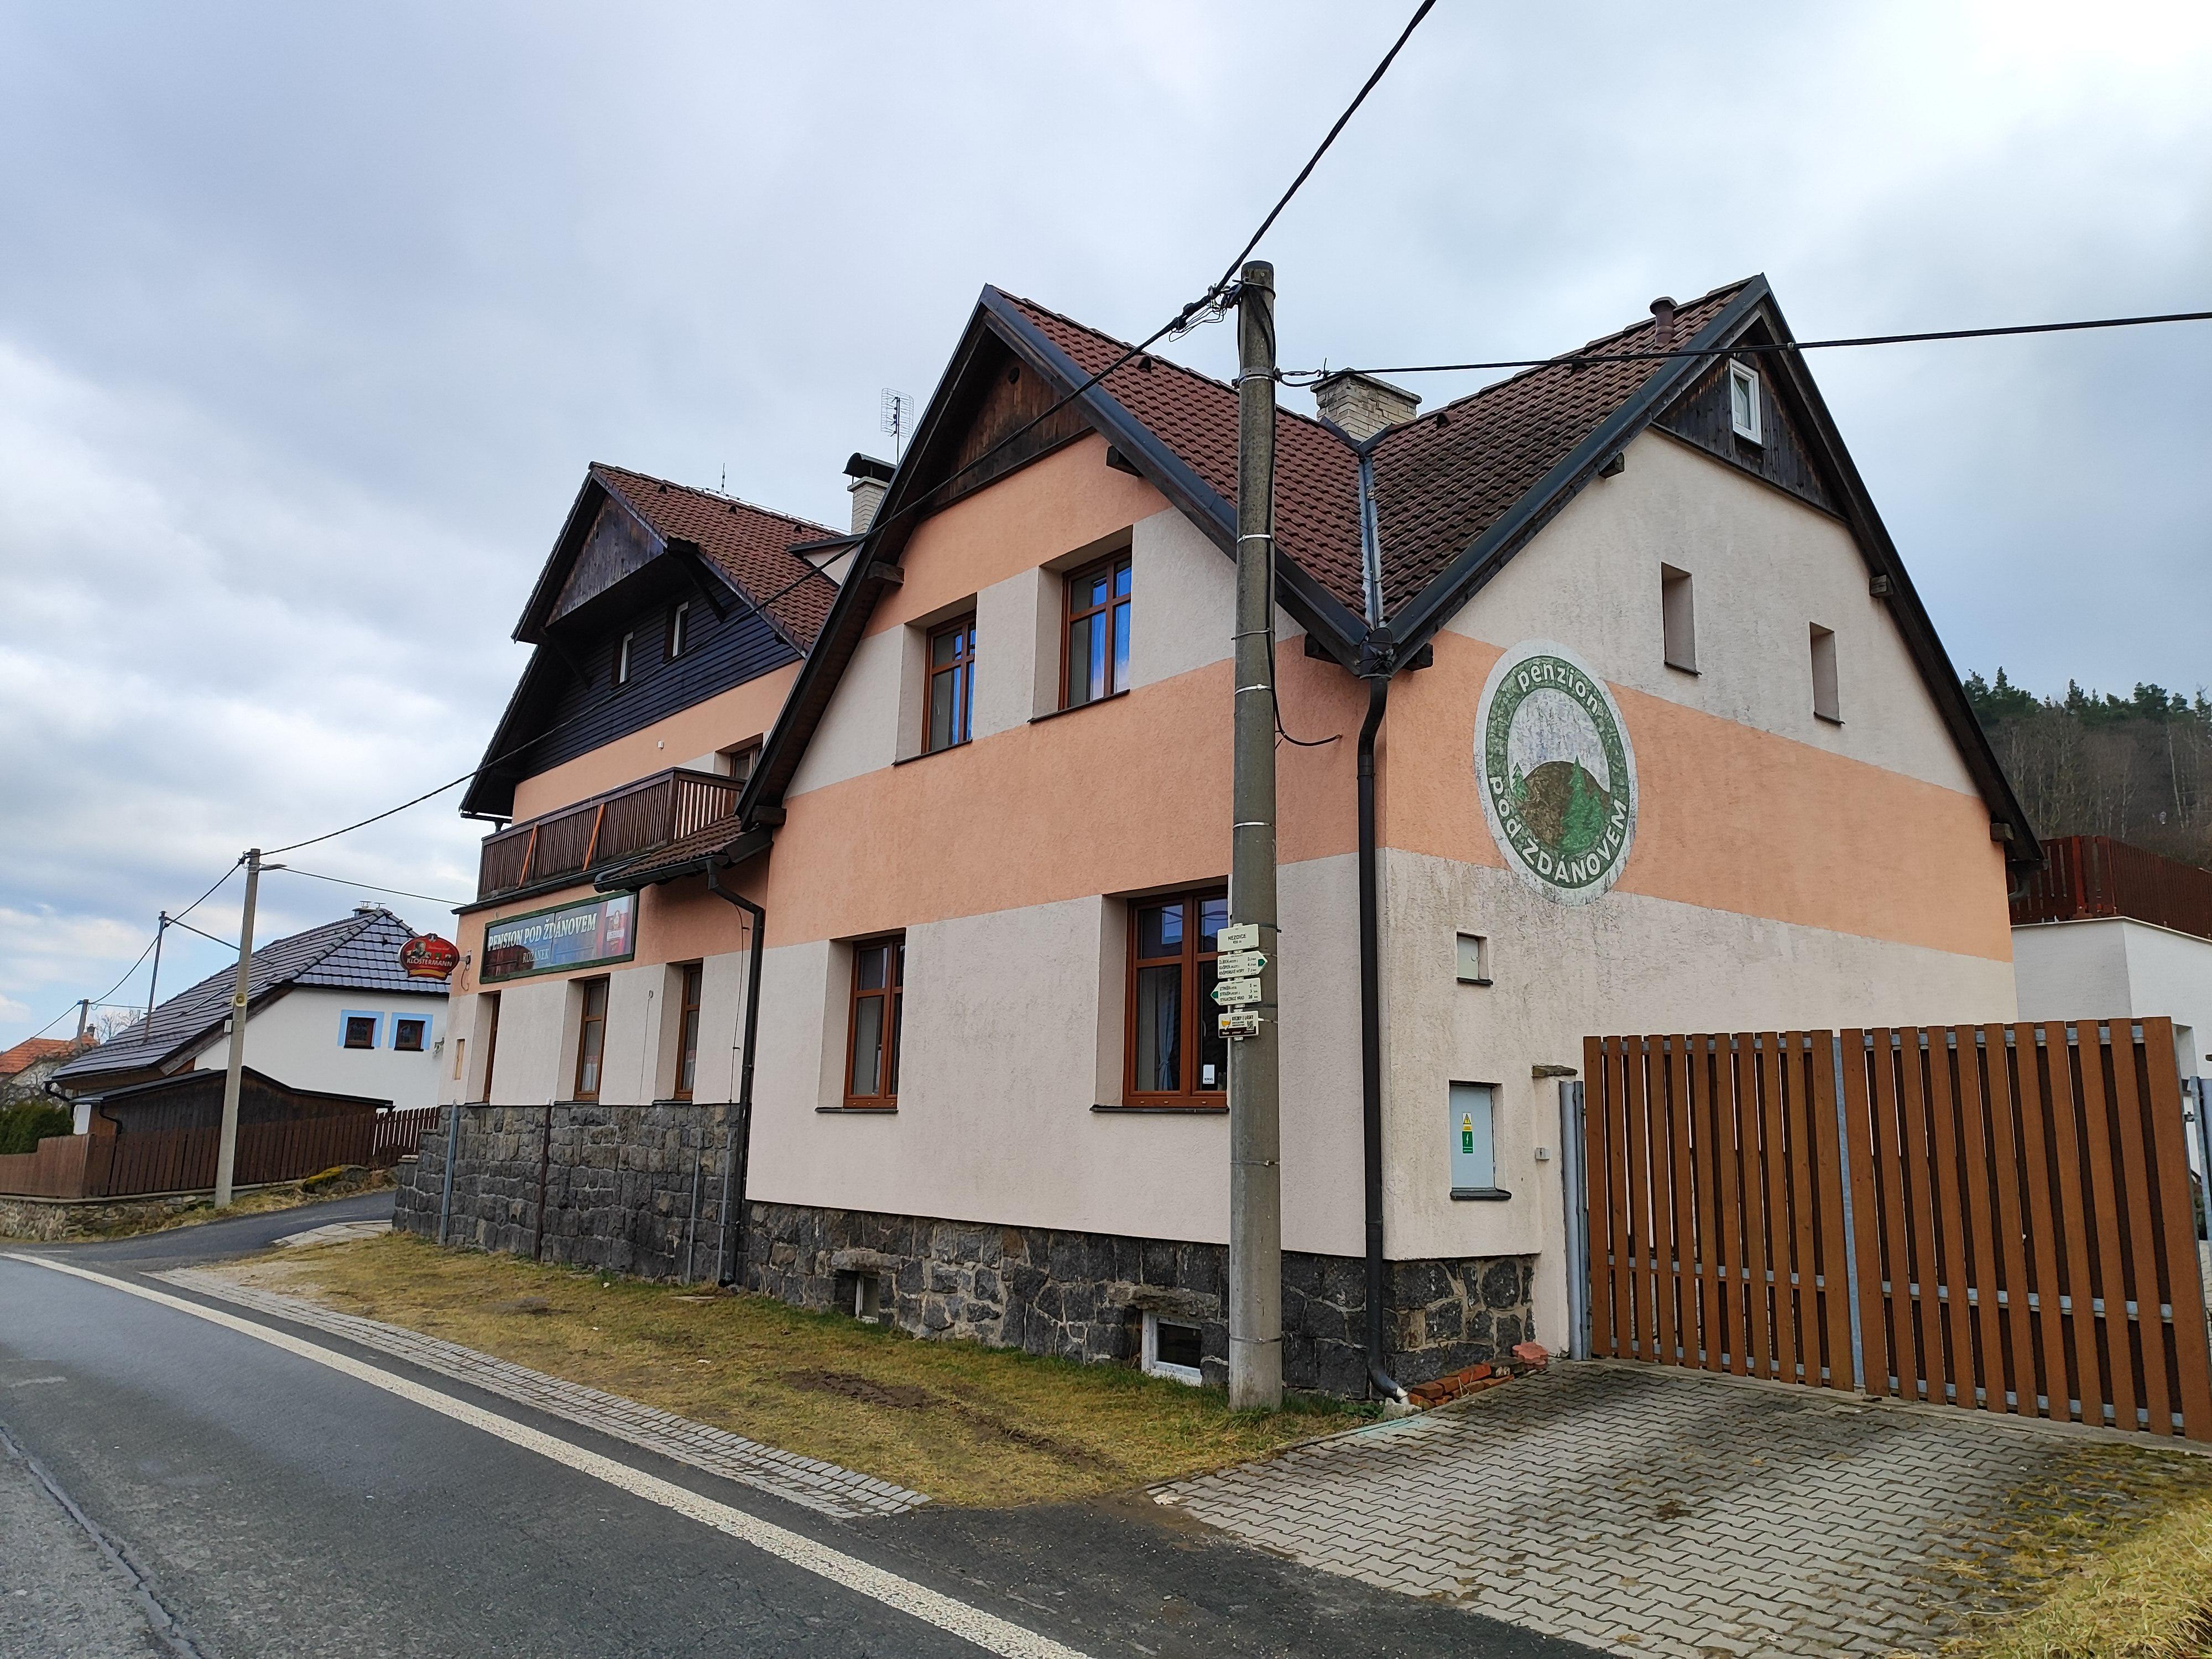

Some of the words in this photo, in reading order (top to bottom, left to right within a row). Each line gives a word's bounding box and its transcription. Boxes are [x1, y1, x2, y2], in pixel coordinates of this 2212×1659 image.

[1517, 664, 1598, 714] penzion
[1522, 799, 1627, 883] ŽDÁNOVEM
[487, 928, 524, 952] PENSION
[524, 927, 542, 945] POD
[543, 912, 597, 941] ŽDÁNOVEM
[406, 957, 452, 967] KLOSTERMANN
[522, 948, 549, 963] ROŽÁNEK
